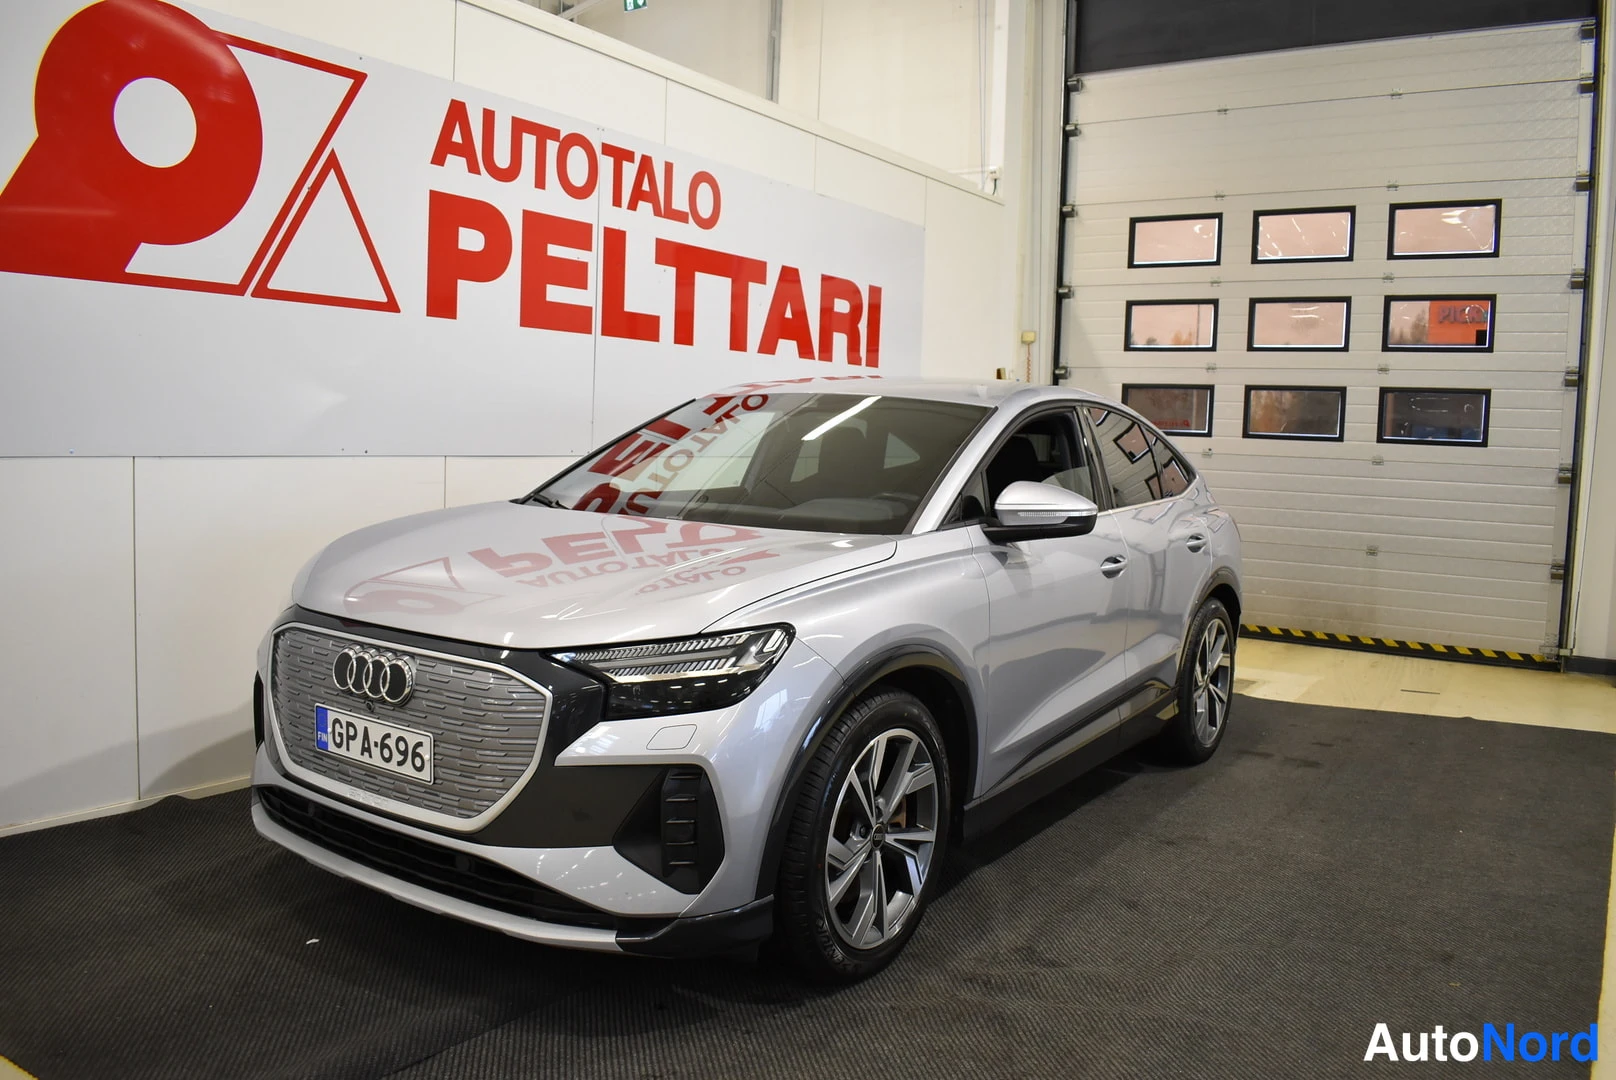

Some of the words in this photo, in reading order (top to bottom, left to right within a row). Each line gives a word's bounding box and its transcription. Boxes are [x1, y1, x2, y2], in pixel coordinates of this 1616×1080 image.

[429, 98, 722, 230] AUTOTALO
[426, 189, 882, 368] PELTTARI
[317, 731, 328, 743] FIN
[332, 718, 425, 772] GPA-696
